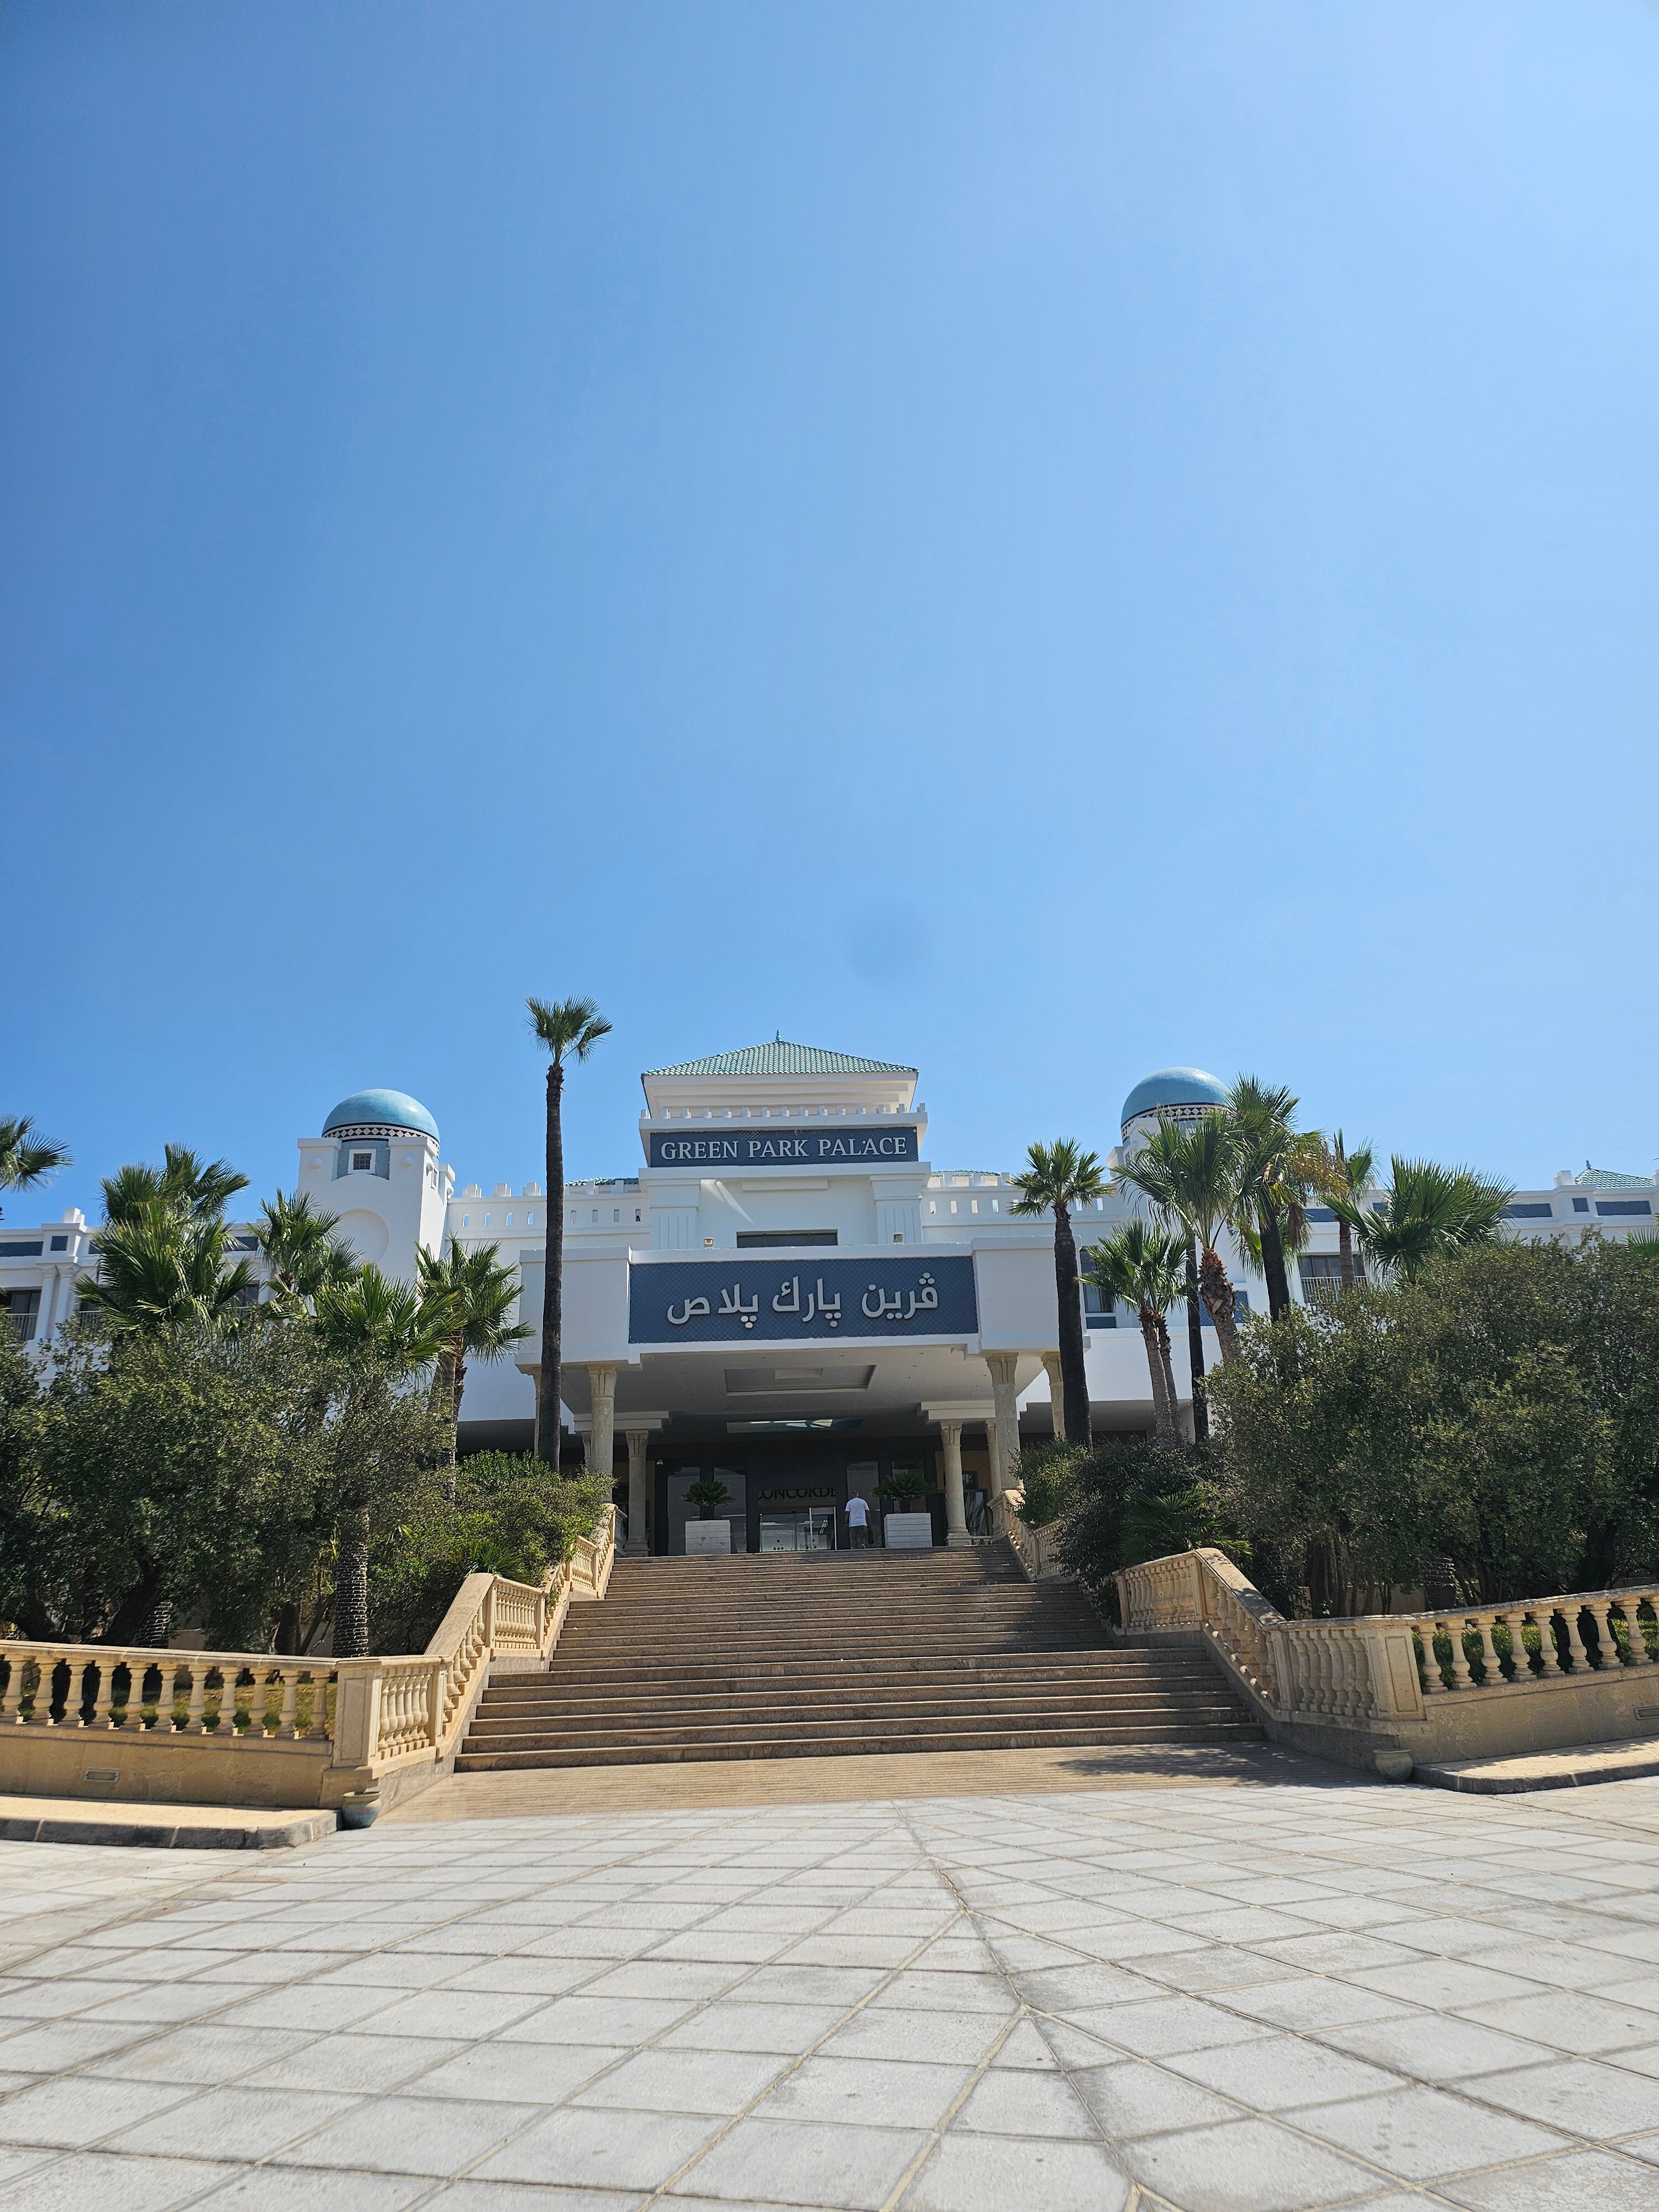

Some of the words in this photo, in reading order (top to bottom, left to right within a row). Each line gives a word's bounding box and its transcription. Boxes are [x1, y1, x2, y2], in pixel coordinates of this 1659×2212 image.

[661, 1141, 739, 1160] GREEN
[748, 1140, 810, 1158] PARK
[818, 1137, 907, 1156] PALACE
